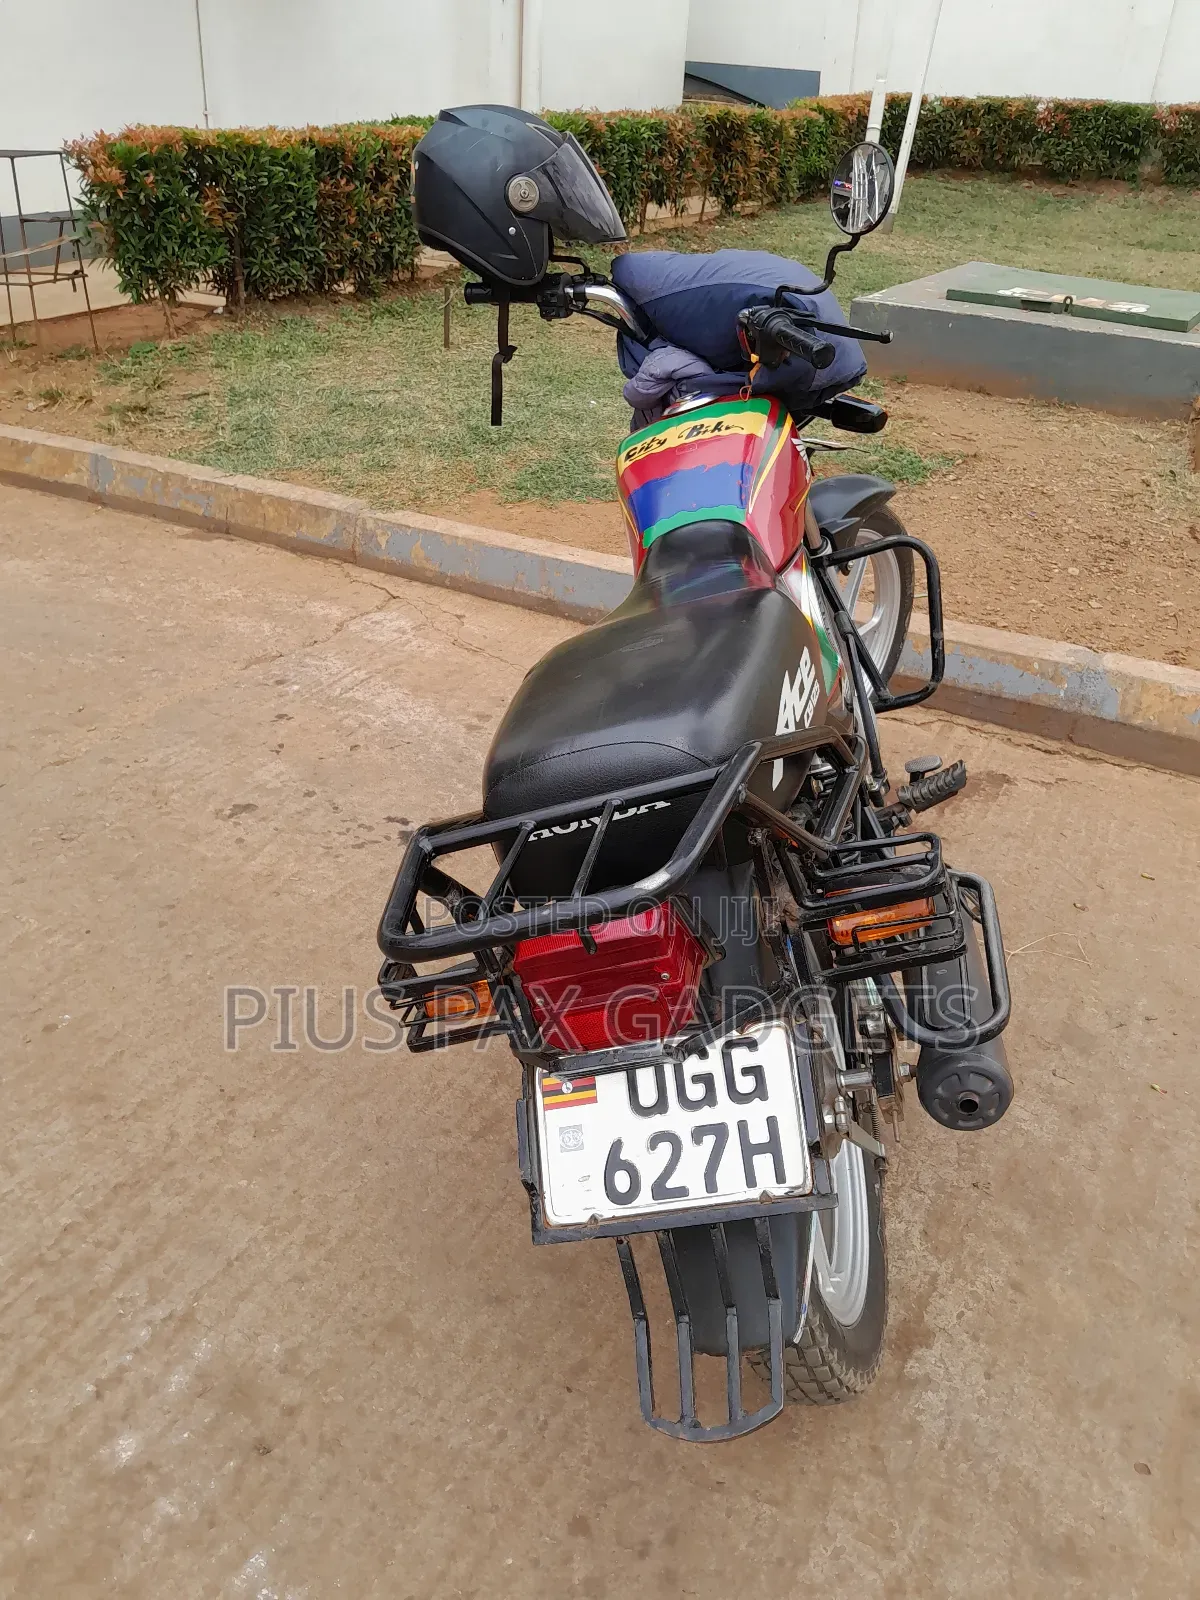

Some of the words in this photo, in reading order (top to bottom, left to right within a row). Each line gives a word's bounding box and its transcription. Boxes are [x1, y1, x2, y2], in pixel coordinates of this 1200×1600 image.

[623, 436, 668, 463] City
[626, 1036, 770, 1118] UGG
[603, 1115, 787, 1206] 627H
